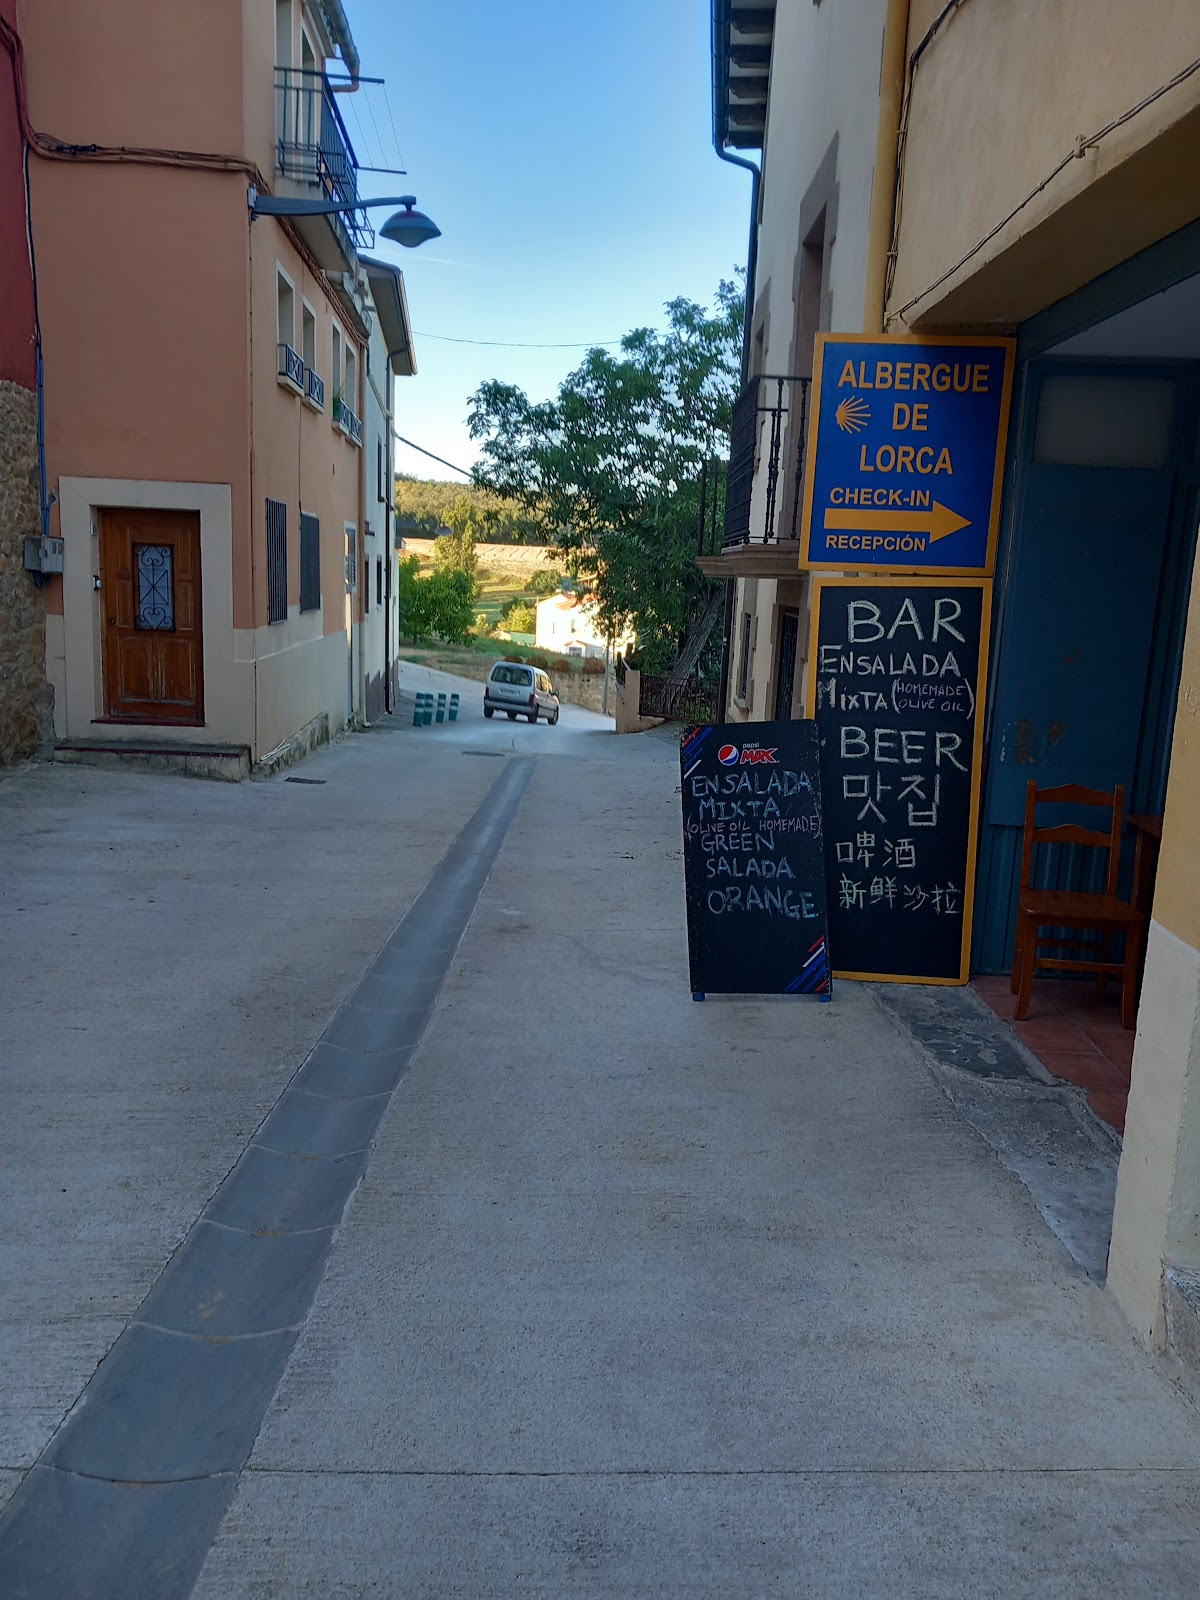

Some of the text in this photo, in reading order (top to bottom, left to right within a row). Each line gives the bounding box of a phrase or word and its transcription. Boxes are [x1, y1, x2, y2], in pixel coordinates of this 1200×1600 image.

[838, 360, 990, 392] ALBERGUE
[892, 403, 929, 431] DE
[860, 444, 954, 474] LORCA
[829, 487, 930, 506] CHECK-IN
[825, 534, 926, 552] RECEPCIÓN
[847, 597, 965, 643] BAR
[819, 644, 961, 678] ENSALADA
[840, 726, 968, 771] BEER
[691, 769, 813, 797] ENSALADA
[699, 796, 780, 821] MIXTA
[842, 771, 942, 826] 맛집
[701, 830, 775, 853] GREEN
[835, 831, 916, 869] 啤酒
[706, 856, 797, 879] SALADA
[708, 885, 817, 920] ORANGE
